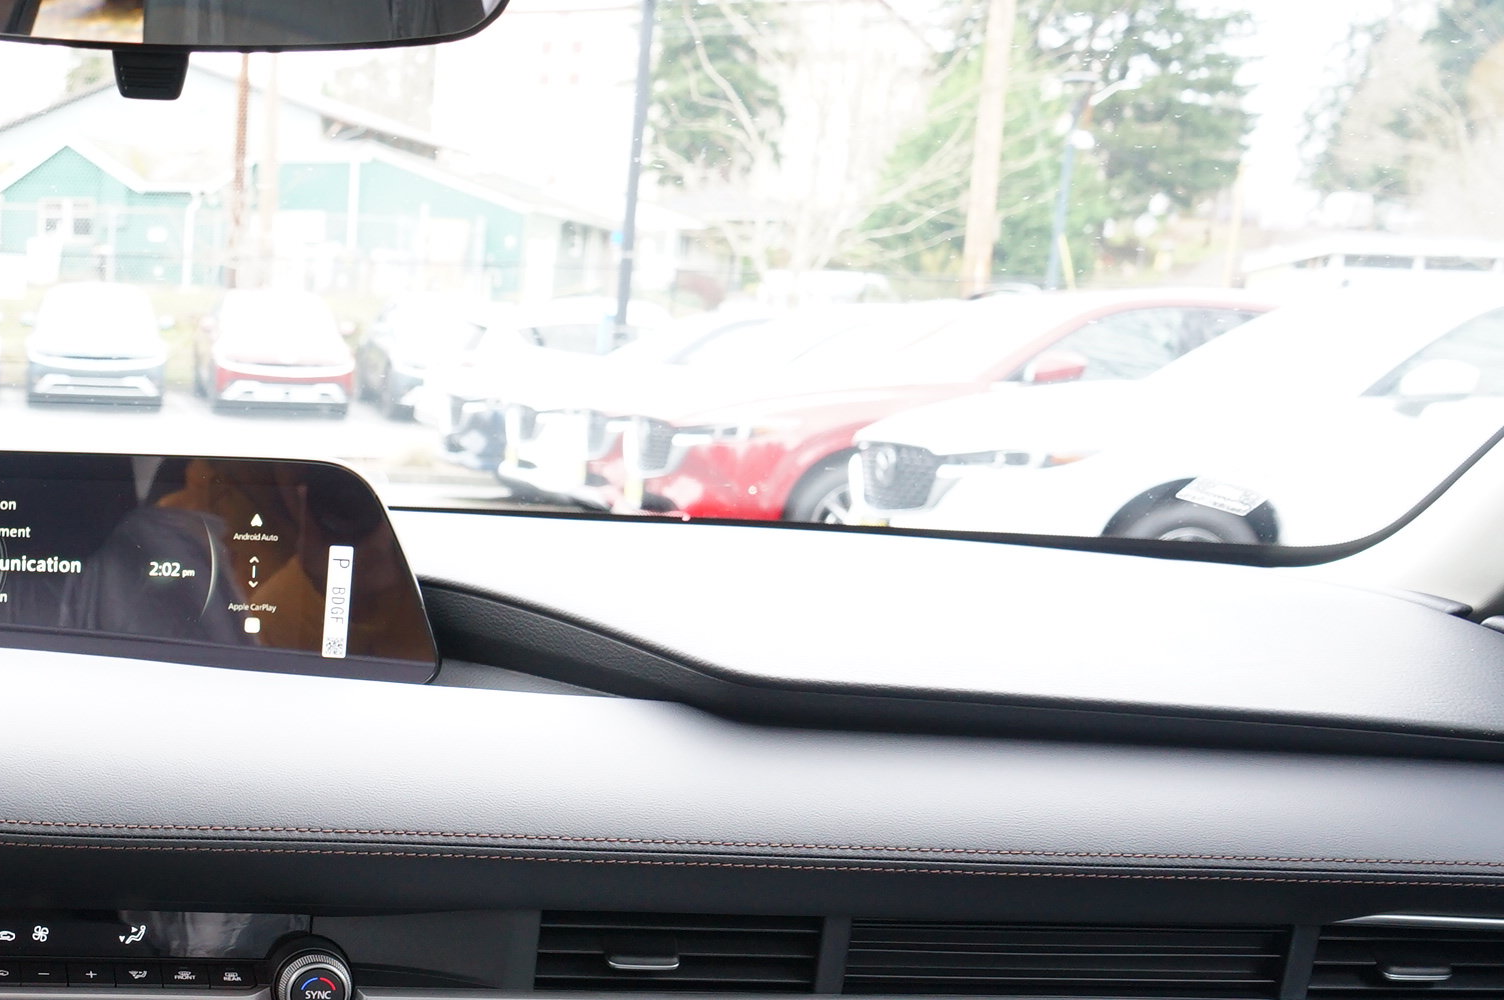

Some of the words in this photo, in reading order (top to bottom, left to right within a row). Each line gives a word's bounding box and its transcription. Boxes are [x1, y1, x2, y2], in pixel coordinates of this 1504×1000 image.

[233, 533, 260, 541] Android
[261, 534, 278, 542] Auto
[333, 559, 350, 569] P
[149, 562, 180, 577] 2:02
[228, 603, 249, 611] Apple
[250, 603, 277, 613] CarPlay
[330, 586, 346, 625] BDGF
[305, 990, 331, 999] SYNC
